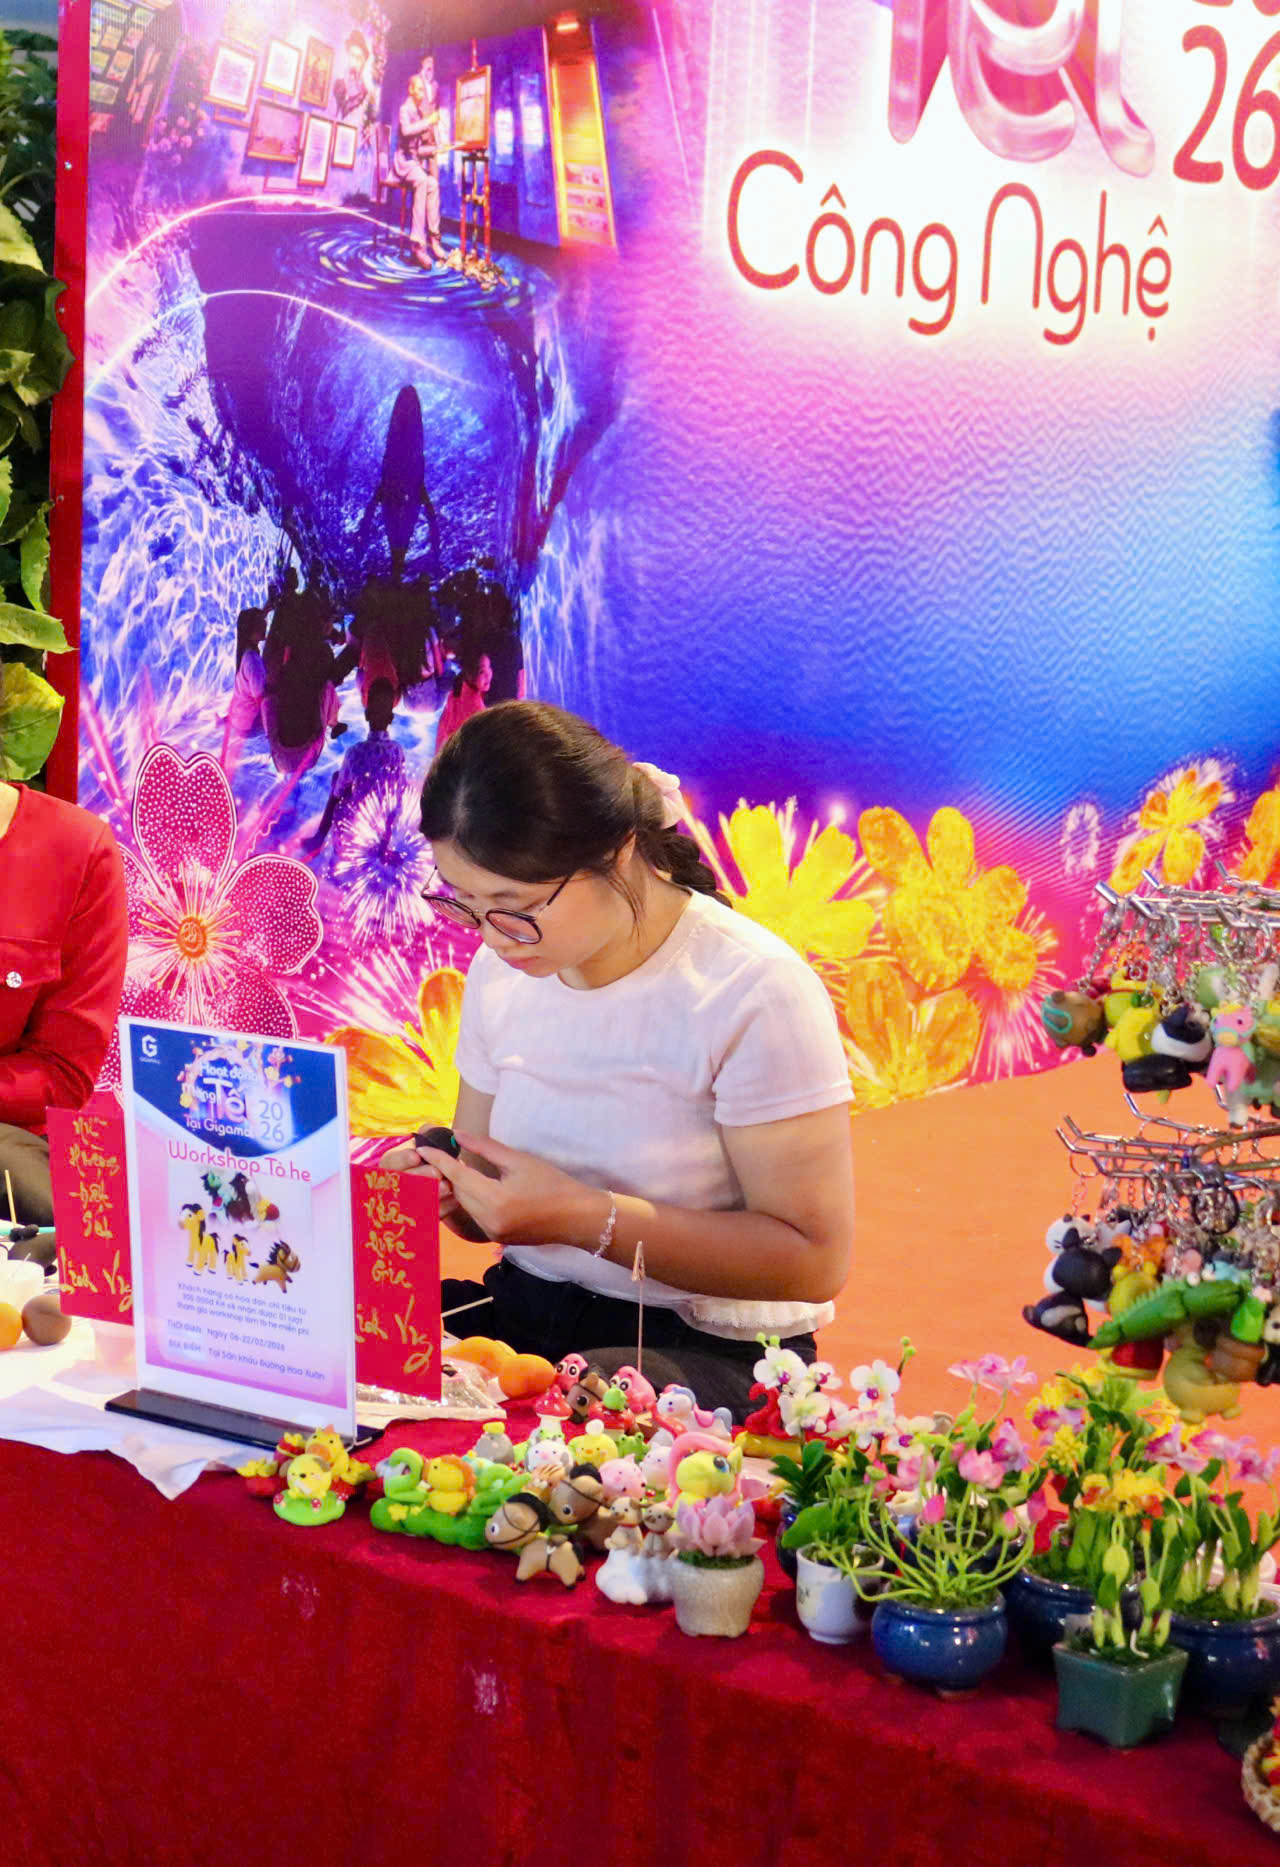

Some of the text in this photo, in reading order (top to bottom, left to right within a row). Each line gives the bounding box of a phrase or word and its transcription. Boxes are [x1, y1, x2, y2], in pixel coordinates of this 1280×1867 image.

[1173, 25, 1279, 190] 26
[727, 150, 1172, 345] Công Nghệ
[183, 1113, 201, 1132] Tại
[259, 1100, 283, 1121] 20
[259, 1121, 284, 1143] 26
[168, 1140, 311, 1182] Workshop Tò he
